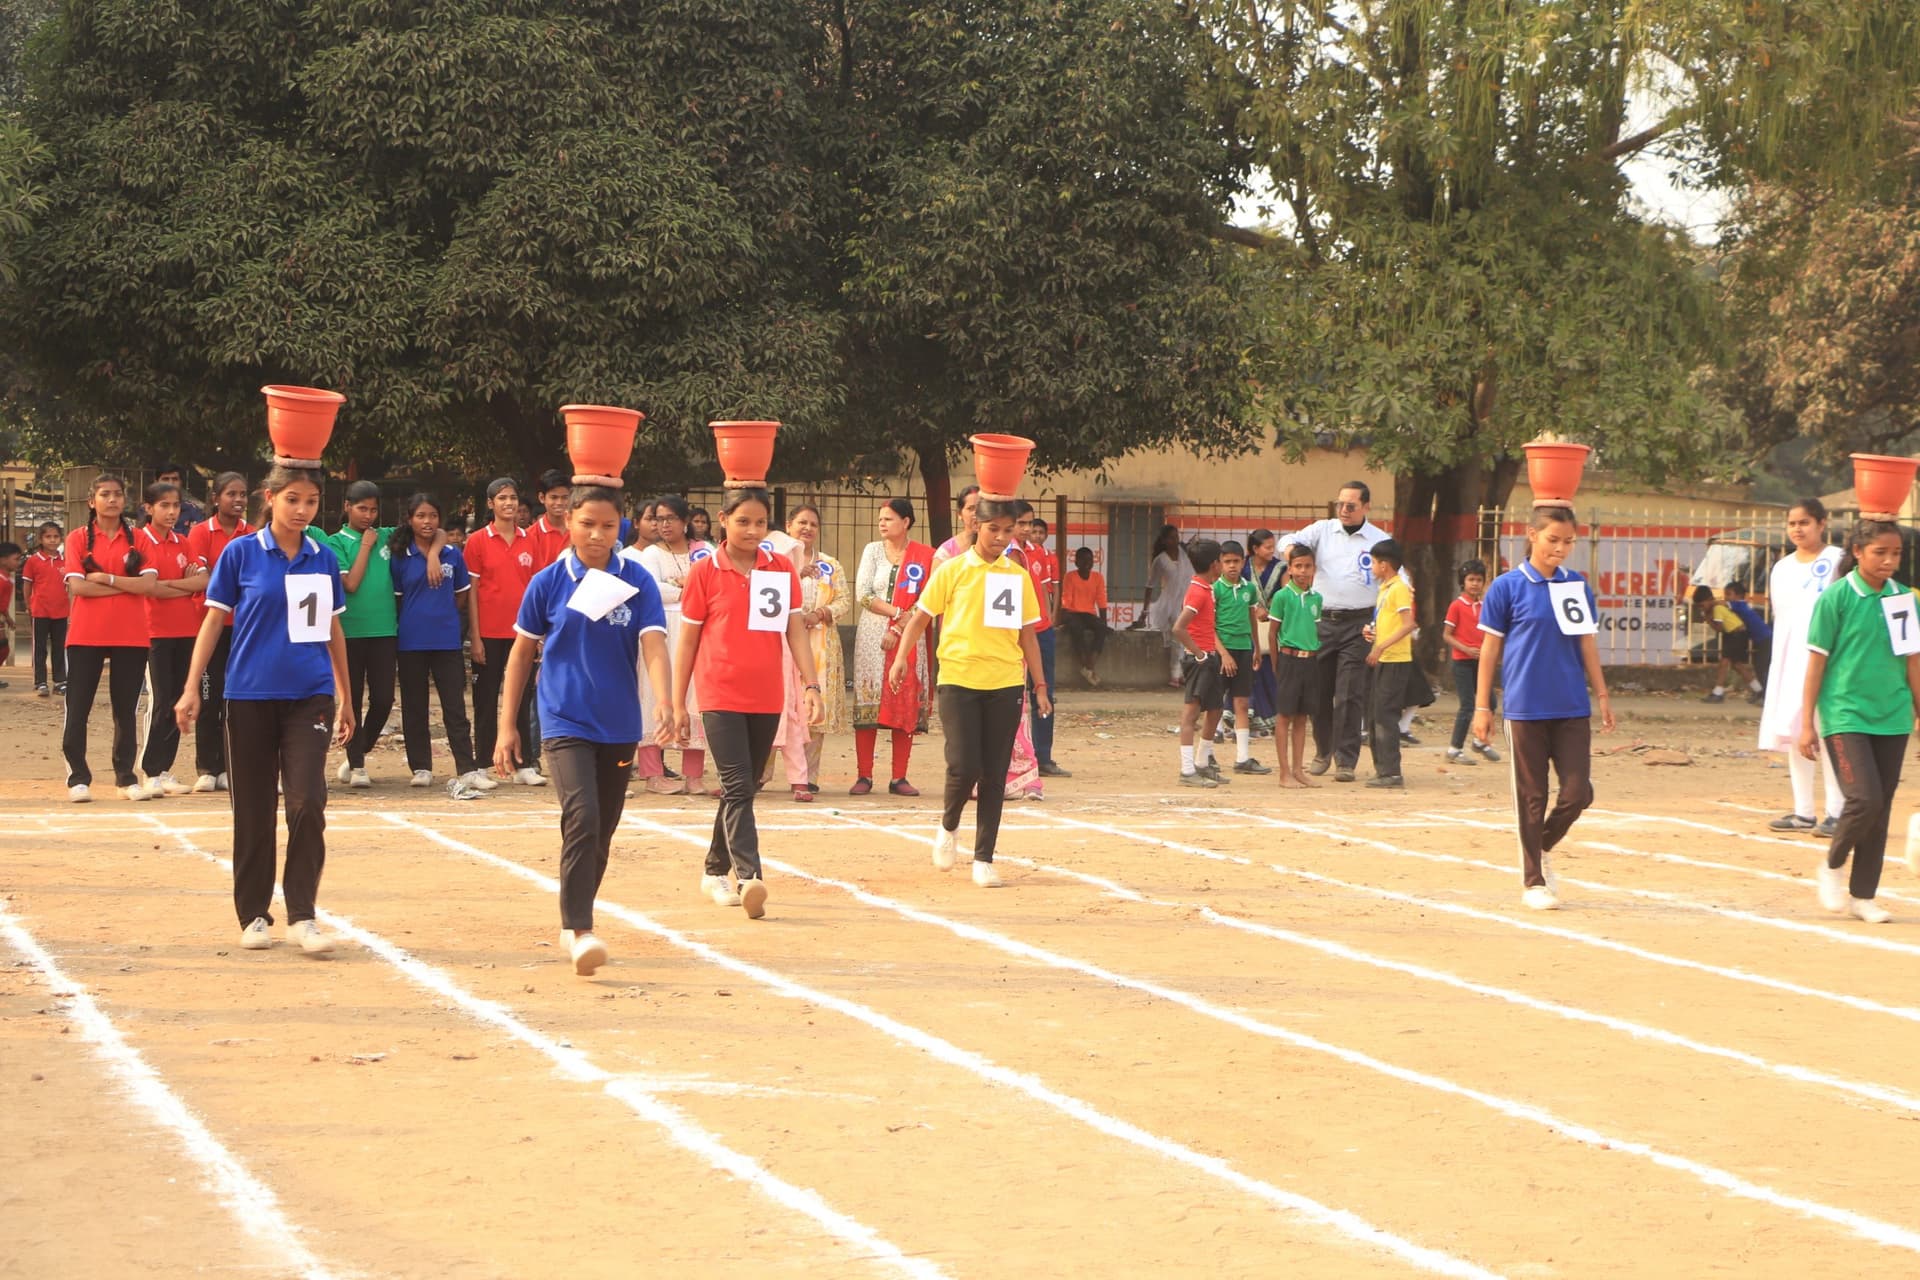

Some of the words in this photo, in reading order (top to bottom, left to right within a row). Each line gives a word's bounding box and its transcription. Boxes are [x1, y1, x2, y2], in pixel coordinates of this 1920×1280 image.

[299, 592, 317, 626] 1
[759, 588, 782, 618] 3
[992, 589, 1015, 616] 4
[1562, 598, 1584, 623] 6
[1892, 610, 1909, 640] 7
